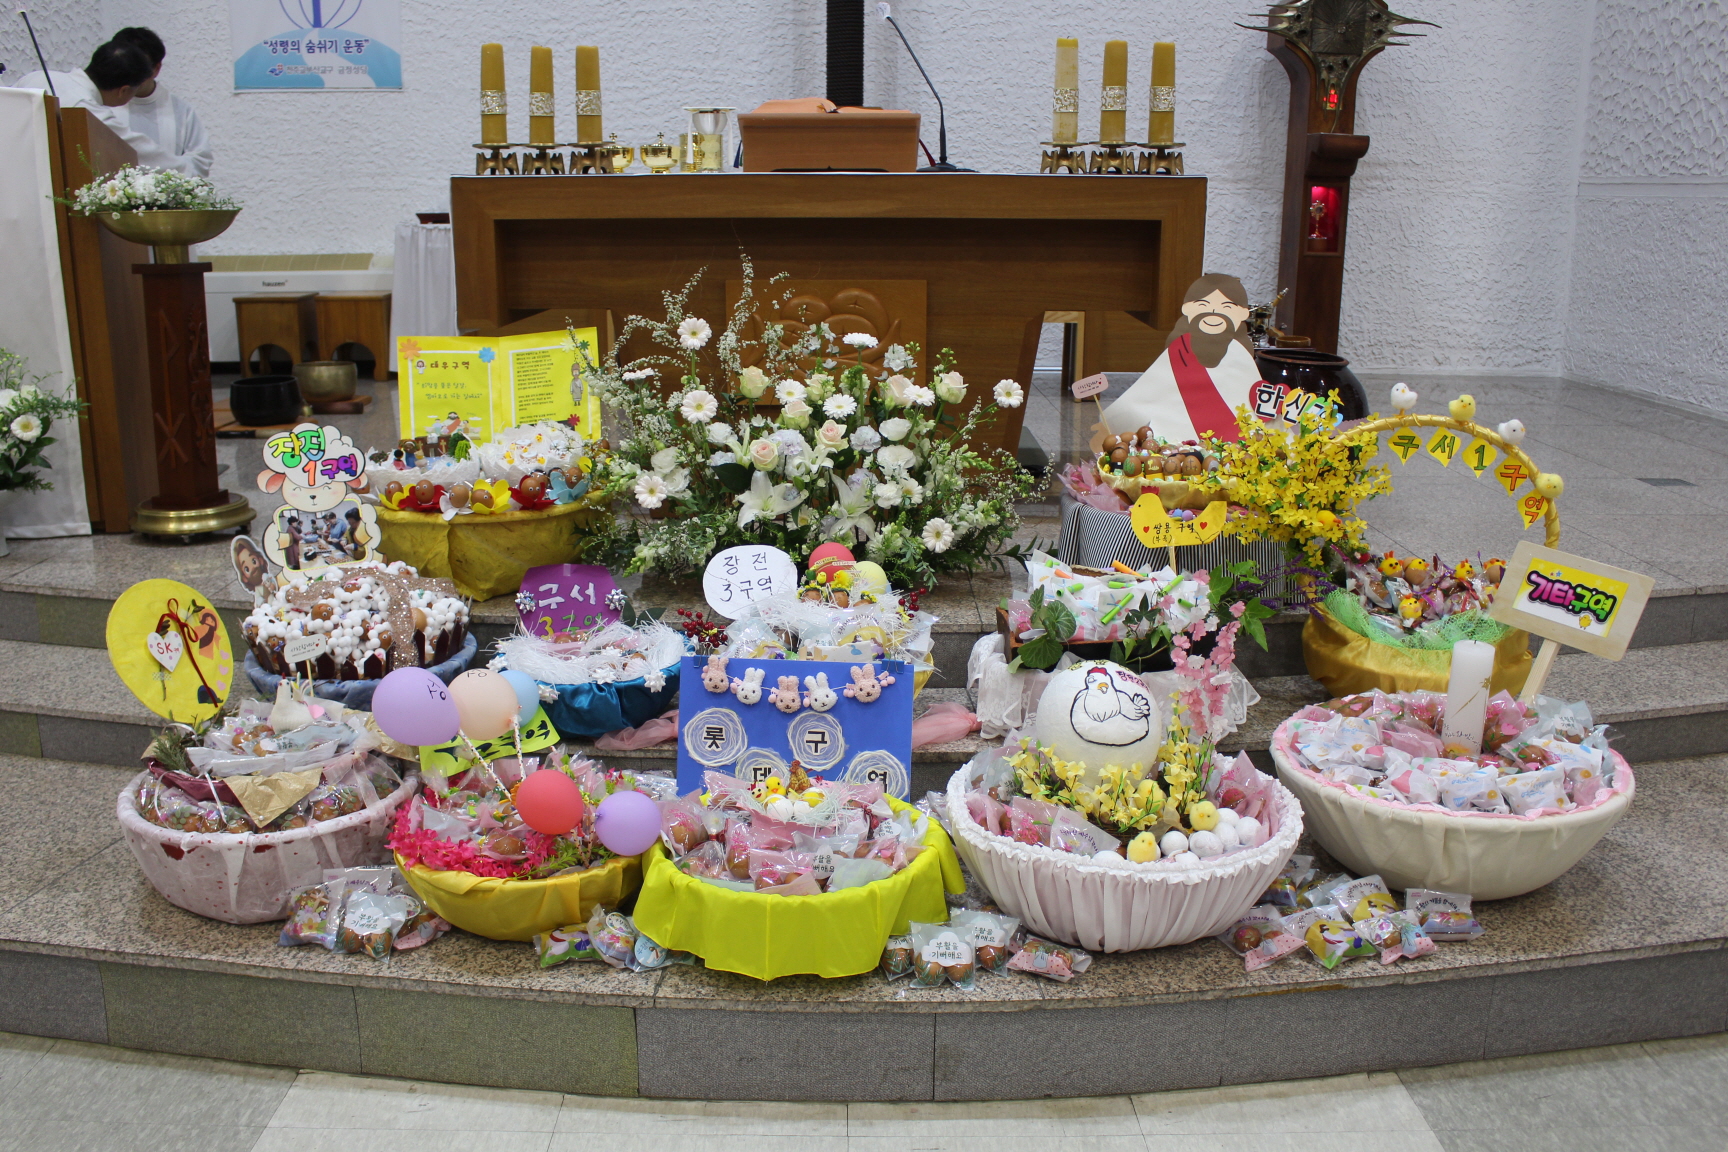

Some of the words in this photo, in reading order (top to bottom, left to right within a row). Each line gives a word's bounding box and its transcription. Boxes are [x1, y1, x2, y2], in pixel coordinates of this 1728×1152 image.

[305, 39, 339, 54] 숨쉬기
[338, 66, 368, 75] 금정성당
[722, 552, 768, 576] 장전
[538, 582, 597, 610] 구서
[720, 575, 773, 602] 3구역
[935, 941, 959, 950] 부활을
[931, 950, 962, 960] 기뻐해요
